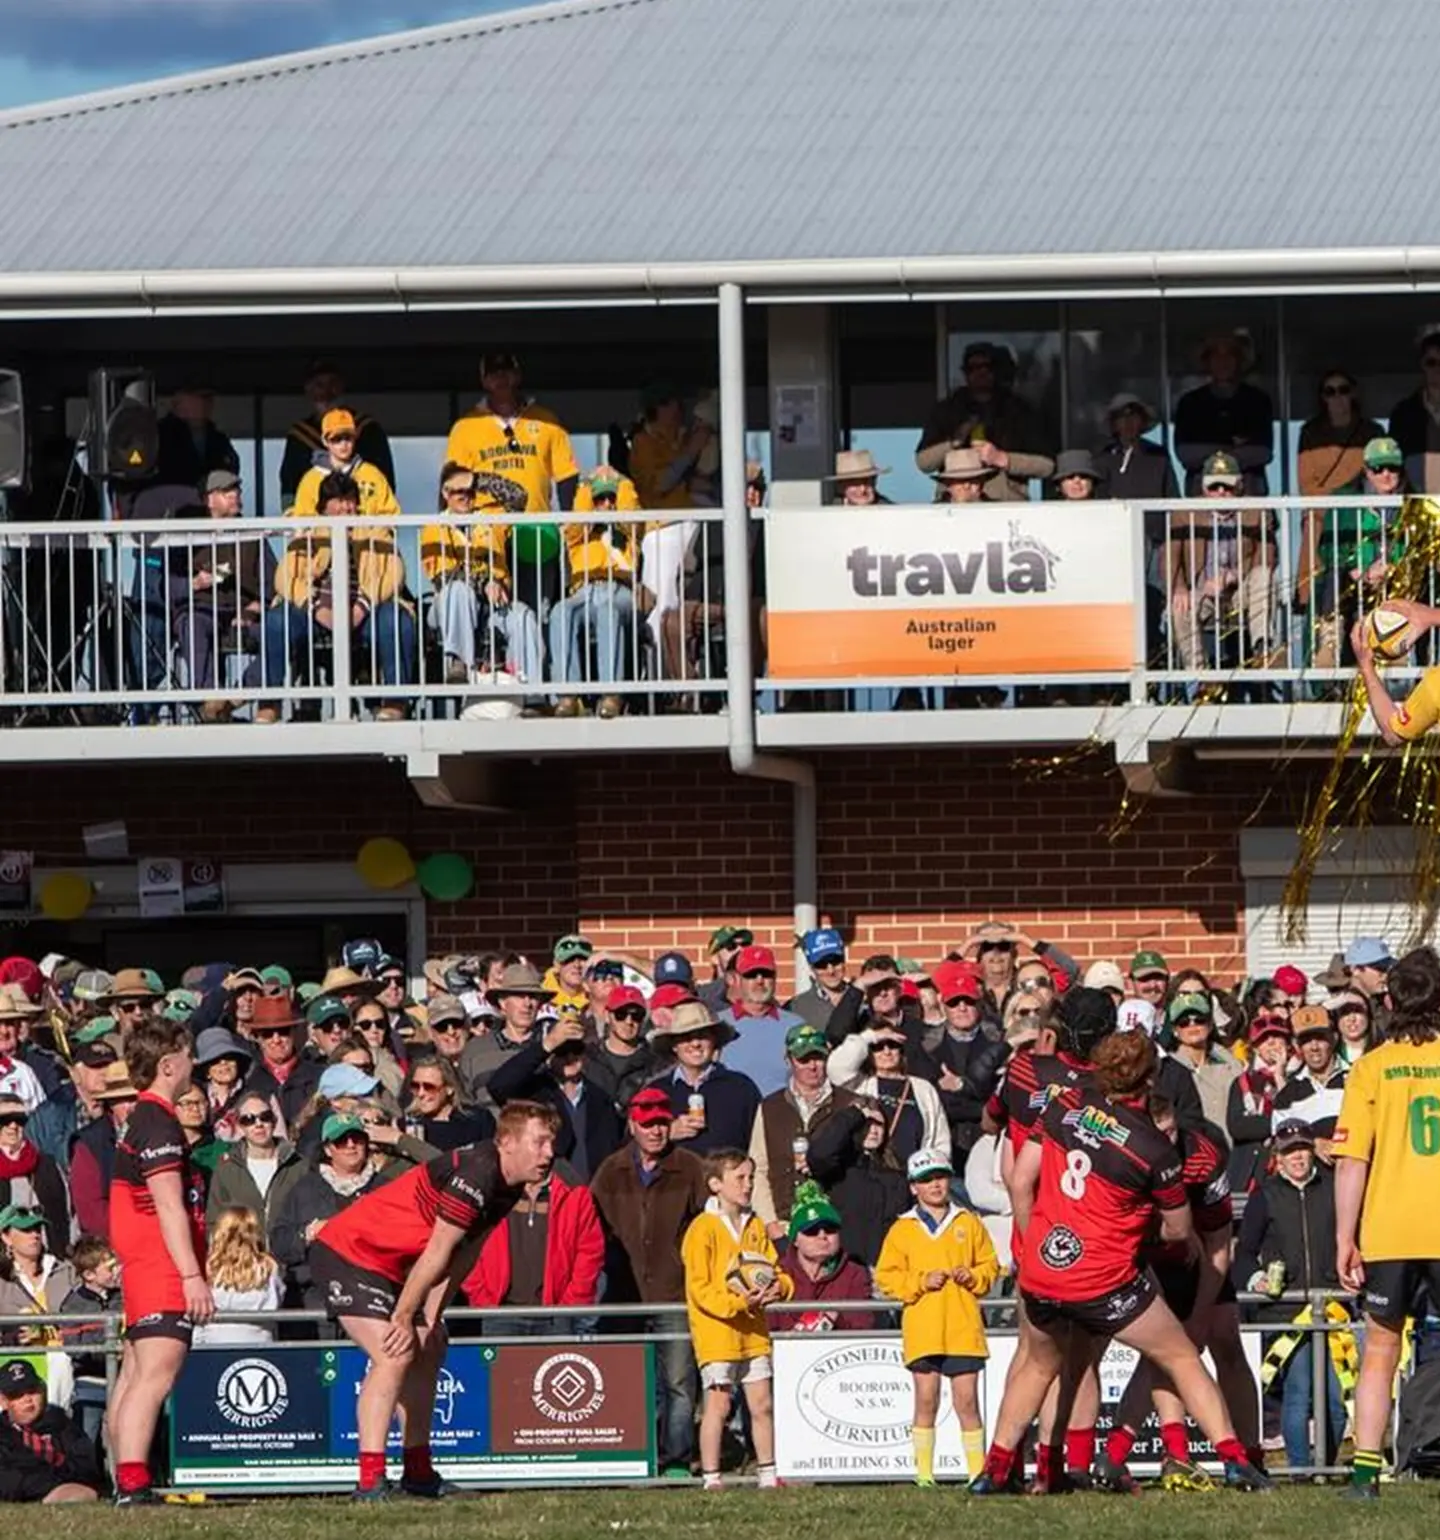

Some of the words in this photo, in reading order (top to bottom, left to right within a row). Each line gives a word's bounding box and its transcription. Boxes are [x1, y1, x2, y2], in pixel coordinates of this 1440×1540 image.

[846, 542, 1049, 597] travla
[905, 617, 997, 635] Australian
[928, 634, 976, 653] lager
[1060, 1150, 1092, 1200] 8
[813, 1346, 901, 1379] STONEHA
[234, 1375, 270, 1408] M
[838, 1381, 912, 1394] BOOROWA
[215, 1395, 291, 1428] MERRIGNEE
[532, 1391, 605, 1423] MERRIGNEE
[817, 1455, 890, 1470] BUILDING
